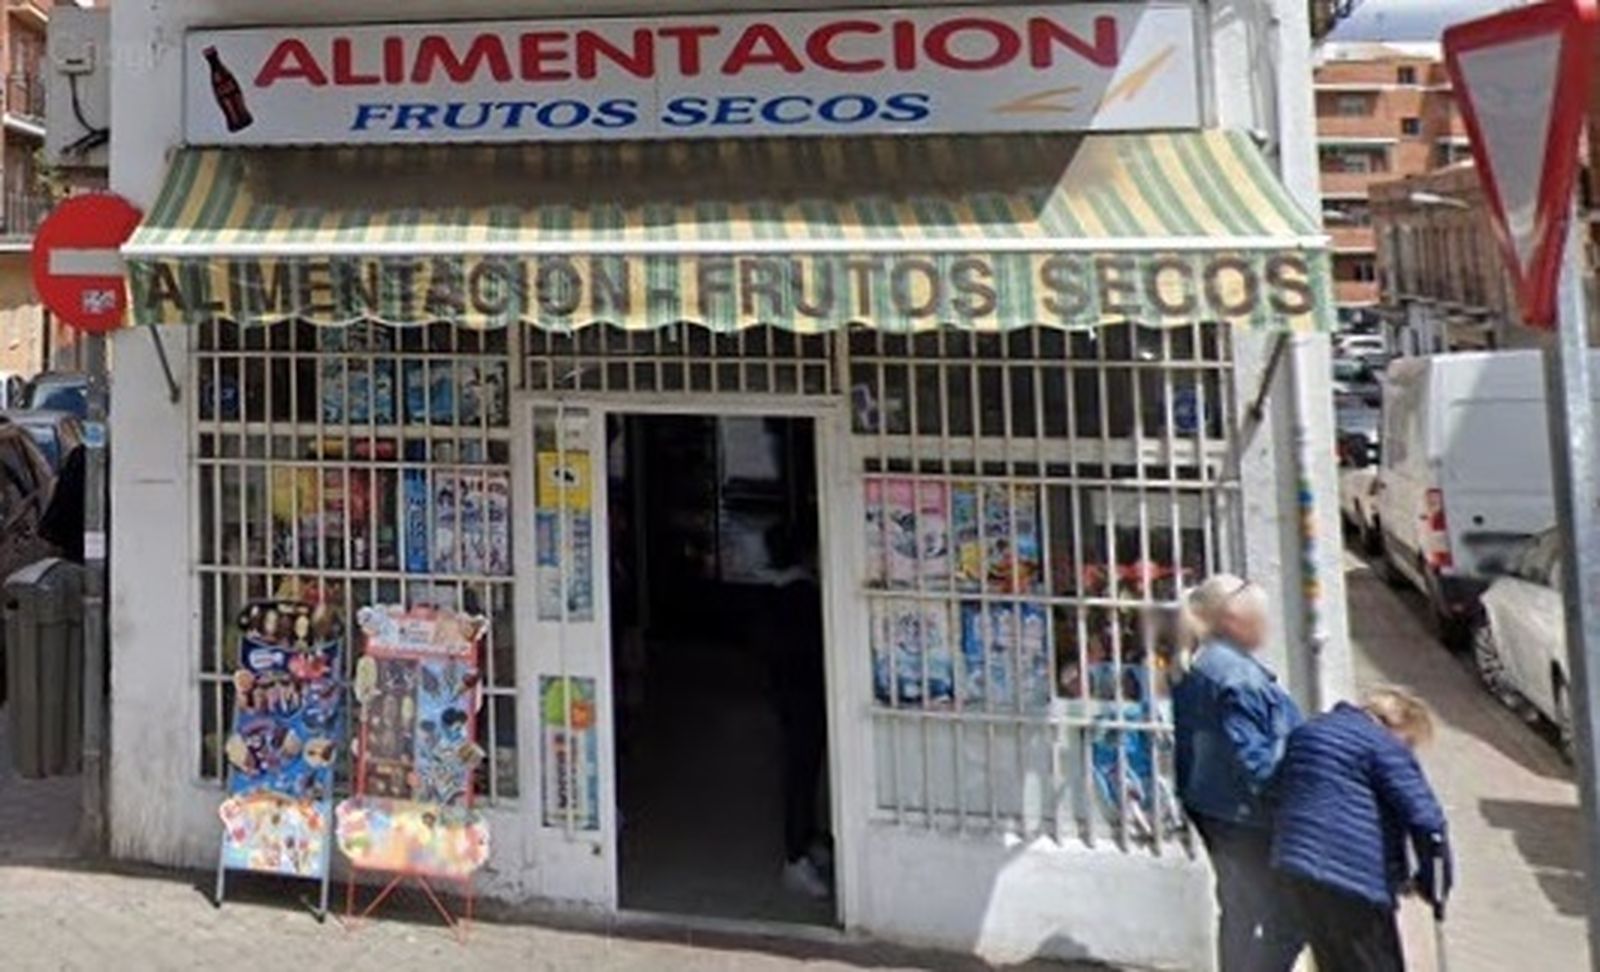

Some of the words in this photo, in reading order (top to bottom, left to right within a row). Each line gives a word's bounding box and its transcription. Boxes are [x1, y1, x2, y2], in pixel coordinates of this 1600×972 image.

[254, 15, 1120, 87] ALIMENTACION
[350, 98, 638, 131] FRUTOS
[662, 93, 931, 127] SECOS
[147, 257, 631, 316] ALIMENTACION
[697, 257, 998, 318] FRUTOS
[1040, 254, 1314, 317] SECOS
